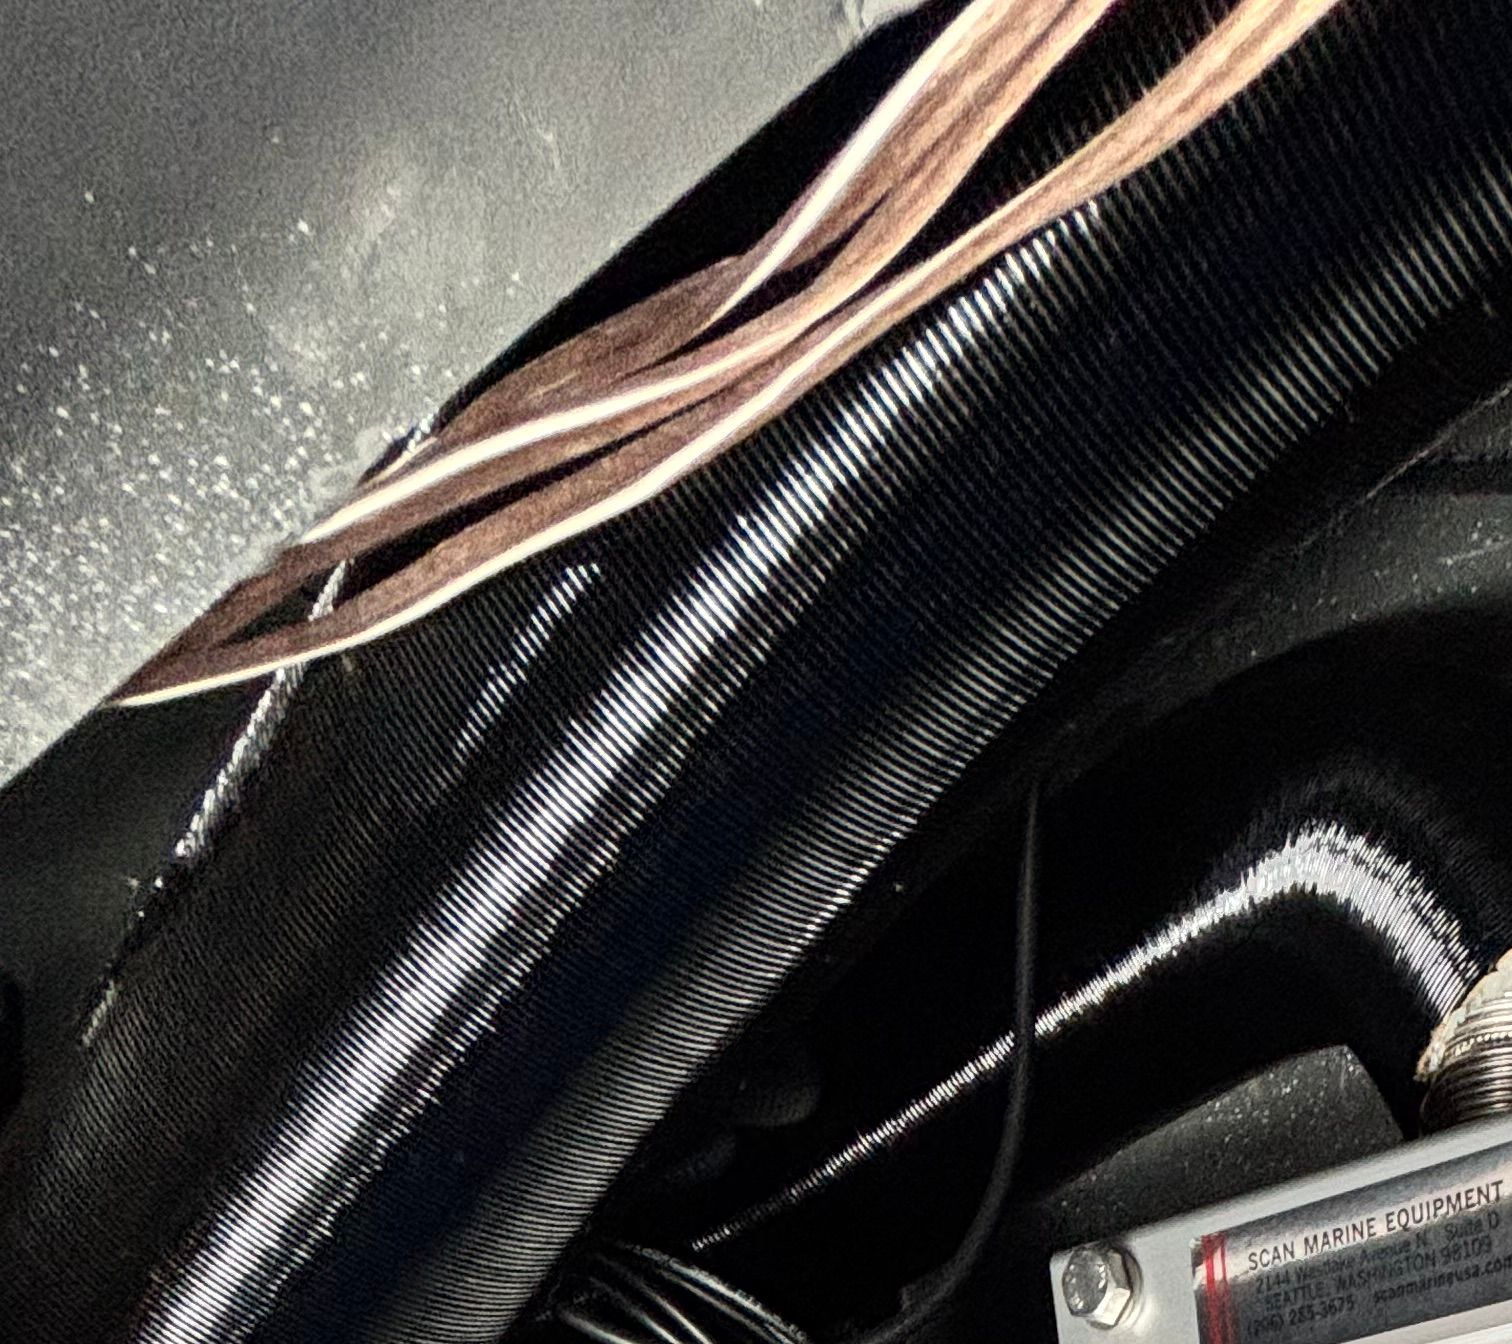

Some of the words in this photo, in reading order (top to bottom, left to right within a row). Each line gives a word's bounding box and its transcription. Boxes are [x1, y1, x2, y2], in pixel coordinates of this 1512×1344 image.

[1247, 1240, 1296, 1272] SCAN
[1302, 1216, 1378, 1257] MARINE
[1384, 1179, 1504, 1233] EQUIPMENT
[1486, 1209, 1501, 1230] D
